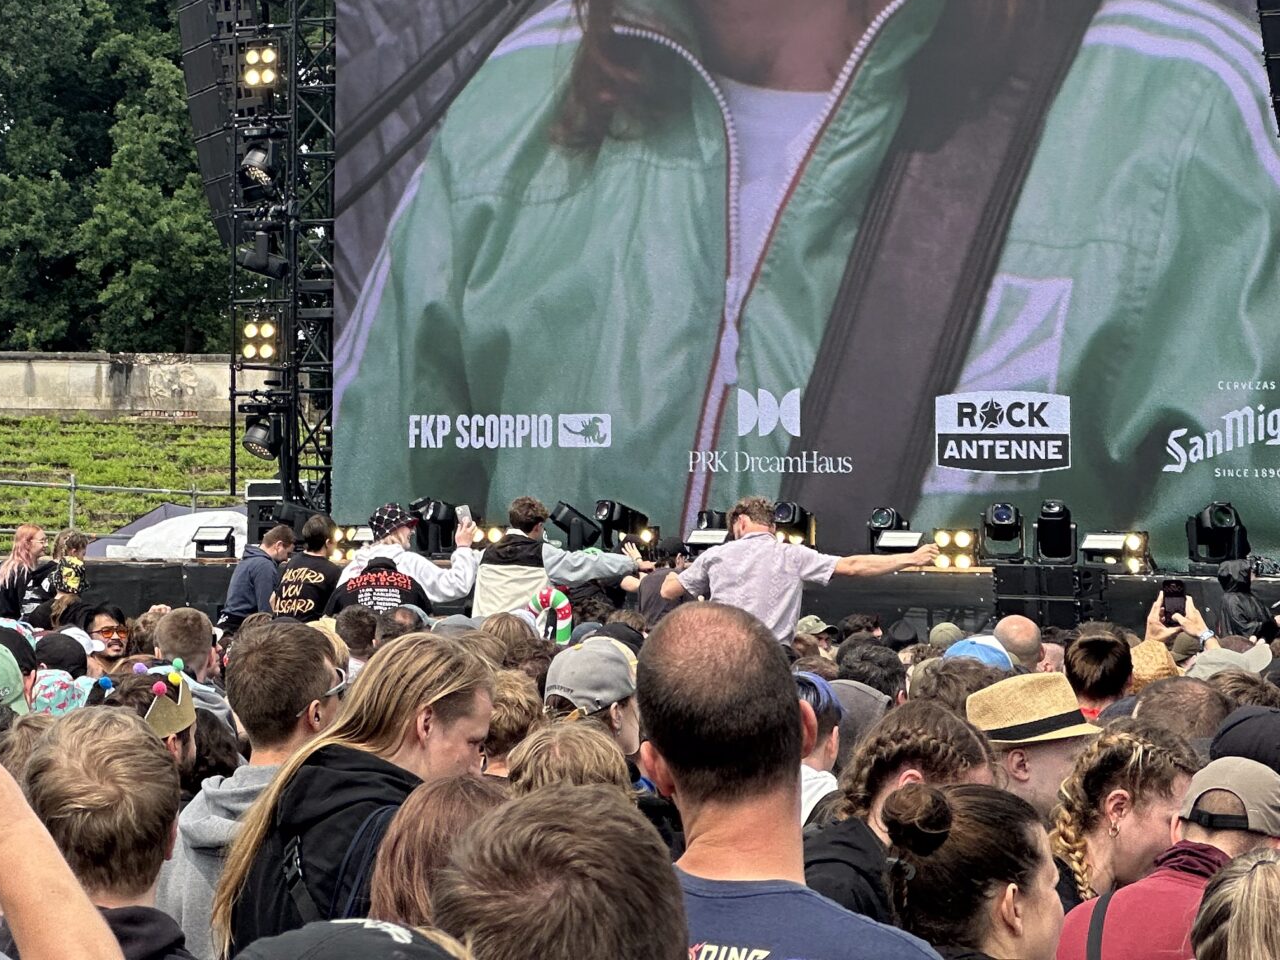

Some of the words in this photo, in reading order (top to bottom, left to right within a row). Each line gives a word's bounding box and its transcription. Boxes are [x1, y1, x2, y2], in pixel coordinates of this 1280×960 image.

[1217, 381, 1276, 390] CERVEZAS
[957, 398, 1050, 431] ROCK
[408, 414, 451, 448] FKP
[455, 413, 553, 449] SCORPIO
[943, 440, 1063, 459] ANTENNE
[688, 450, 729, 473] PRK
[735, 450, 853, 474] DreamHaus
[1214, 468, 1249, 478] SINCE
[282, 584, 303, 598] VON
